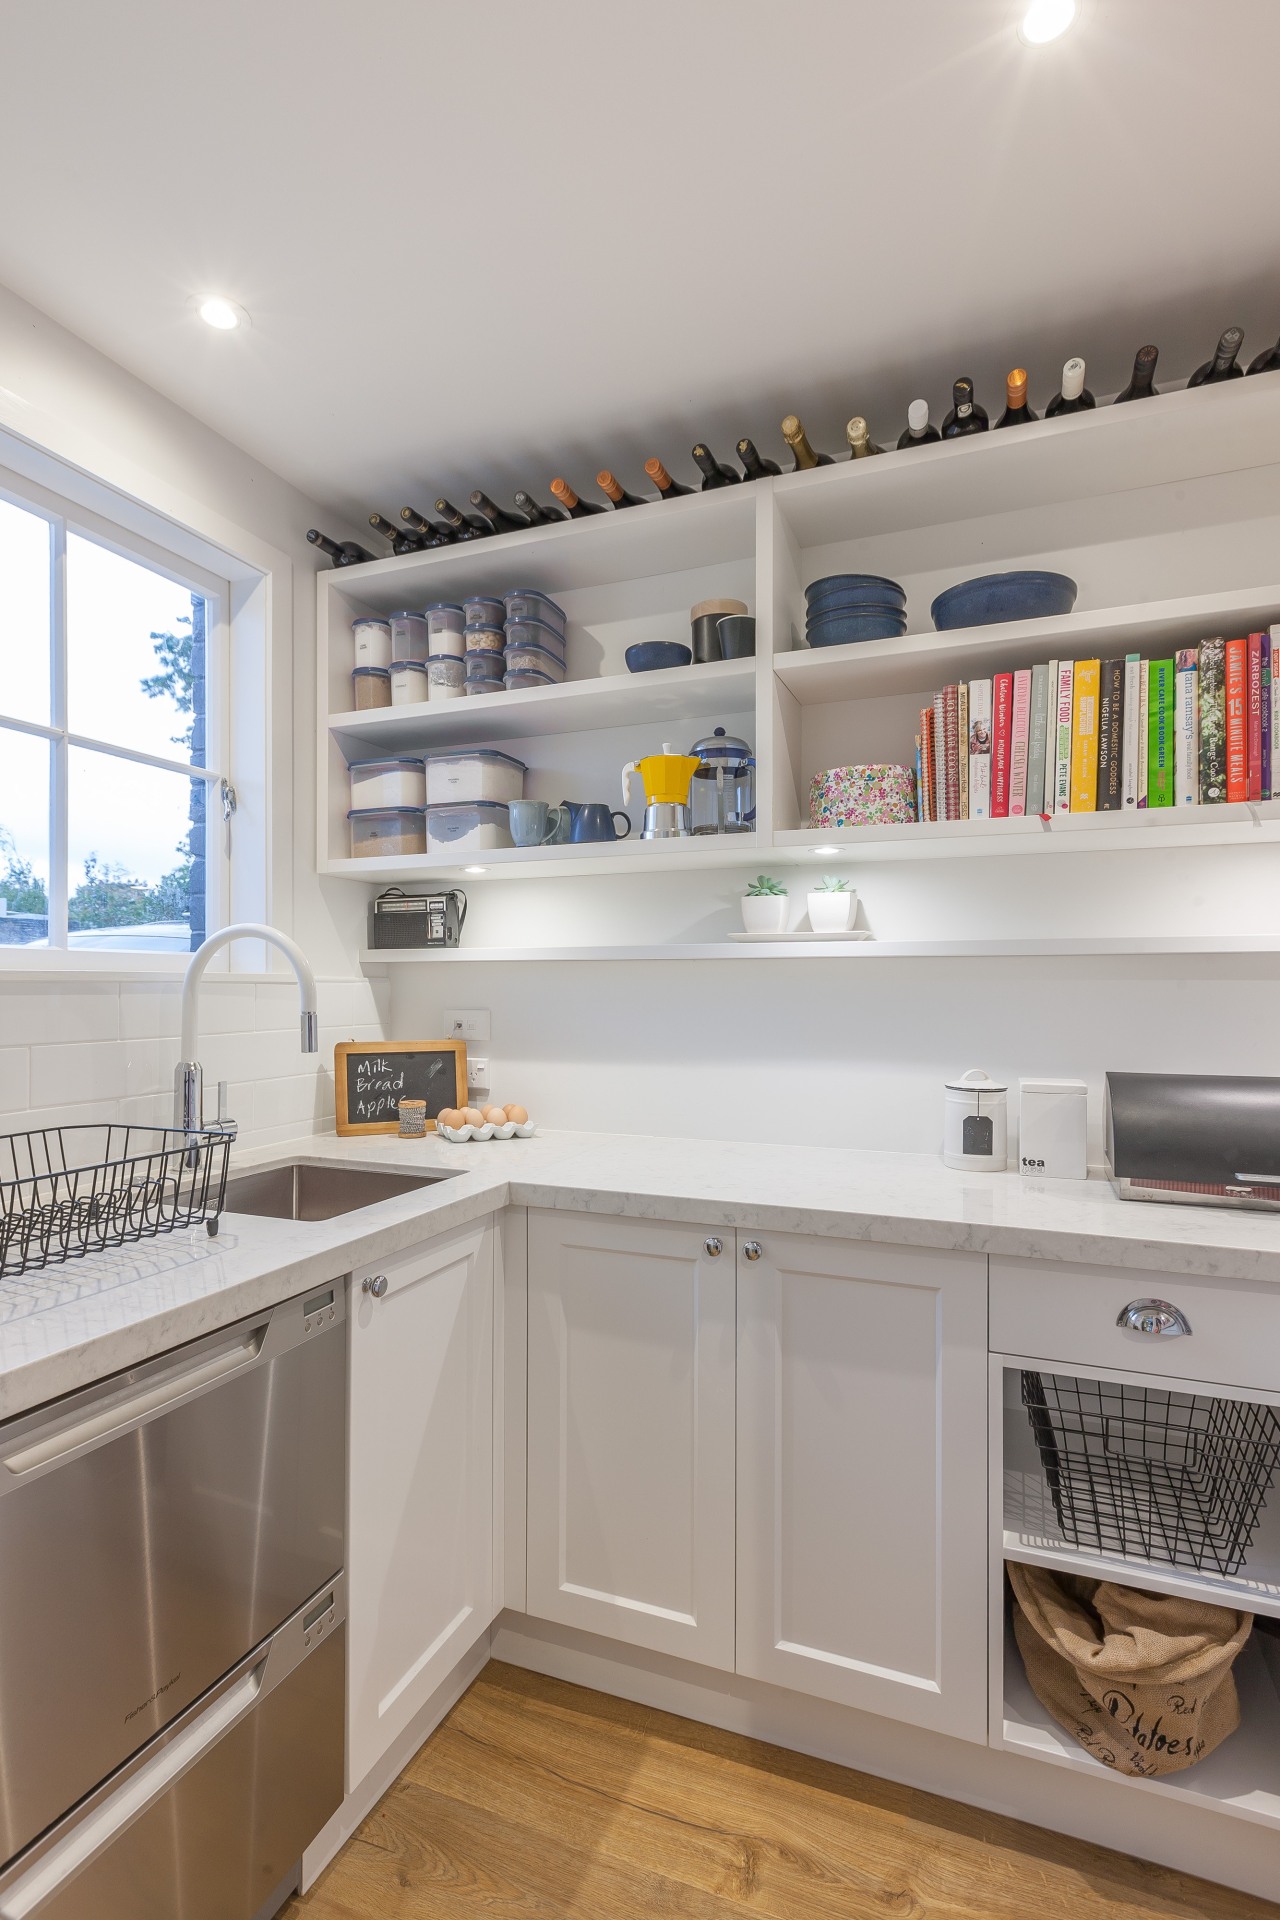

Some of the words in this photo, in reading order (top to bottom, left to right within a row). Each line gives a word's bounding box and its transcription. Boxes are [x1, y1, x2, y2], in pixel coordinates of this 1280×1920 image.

[1185, 673, 1193, 694] tana
[1229, 647, 1242, 695] JAMIE'S
[1251, 650, 1260, 715] ZARBOZEST
[999, 679, 1008, 702] Chelsea
[1017, 675, 1028, 705] EVERYDAY
[1060, 670, 1071, 699] FAMILY
[1113, 691, 1120, 700] TO
[946, 698, 955, 710] JO
[998, 704, 1006, 727] Winter
[1059, 702, 1070, 723] FOOD
[1101, 698, 1109, 730] NIGELLA
[1113, 703, 1119, 711] BE
[1228, 698, 1243, 715] 15
[946, 711, 956, 748] SEAGAR
[1016, 706, 1026, 738] DELICIOUS
[1182, 697, 1194, 740] ramsay's
[1111, 722, 1119, 758] DOMESTIC
[1229, 718, 1243, 751] MINUTE
[997, 739, 1005, 770] HOMEMADE
[1014, 741, 1025, 769] CHELSEA
[1100, 733, 1108, 768] LAWSON
[1185, 752, 1193, 768] family
[1207, 737, 1218, 760] Range
[948, 750, 957, 783] COOKS
[1059, 764, 1067, 777] PETE
[1109, 761, 1117, 795] GODDESS
[1210, 762, 1218, 782] Cook
[1230, 754, 1244, 783] MEALS
[996, 772, 1004, 803] HAPPINESS
[1012, 772, 1024, 797] WINTER
[1059, 779, 1067, 796] EVANS
[358, 1059, 392, 1076] Milk
[357, 1072, 404, 1092] Bread
[1022, 1157, 1045, 1167] tea
[1167, 1695, 1197, 1715] Red
